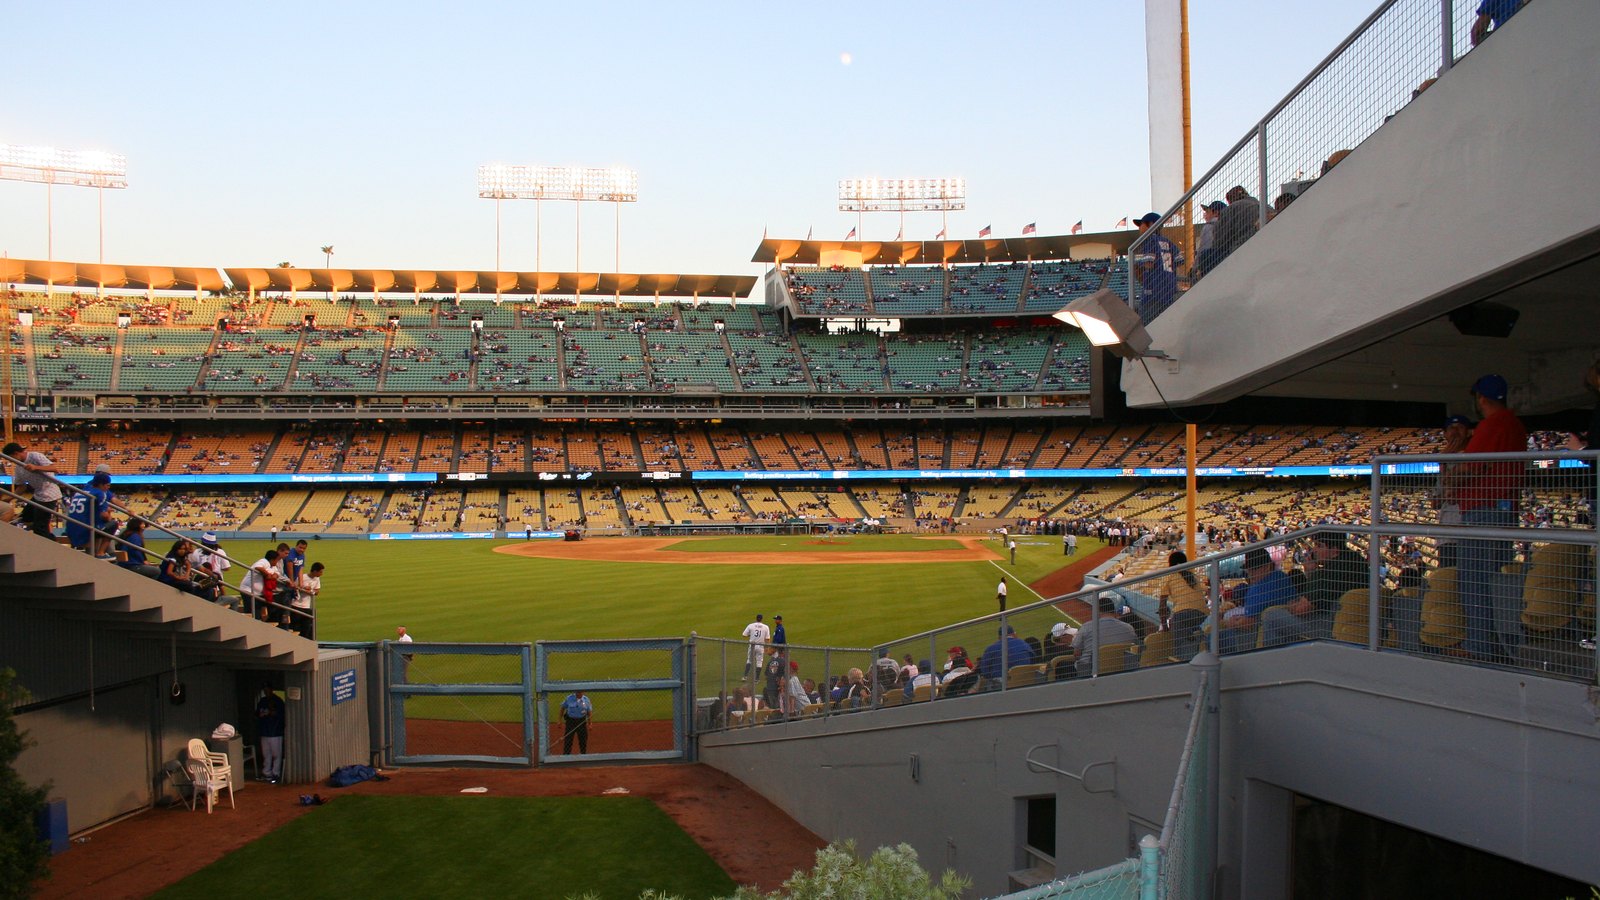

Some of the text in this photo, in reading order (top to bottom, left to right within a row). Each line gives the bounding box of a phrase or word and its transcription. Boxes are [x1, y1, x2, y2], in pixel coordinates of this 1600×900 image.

[1208, 467, 1232, 475] Stadium
[69, 498, 87, 514] 55
[754, 629, 762, 638] 31
